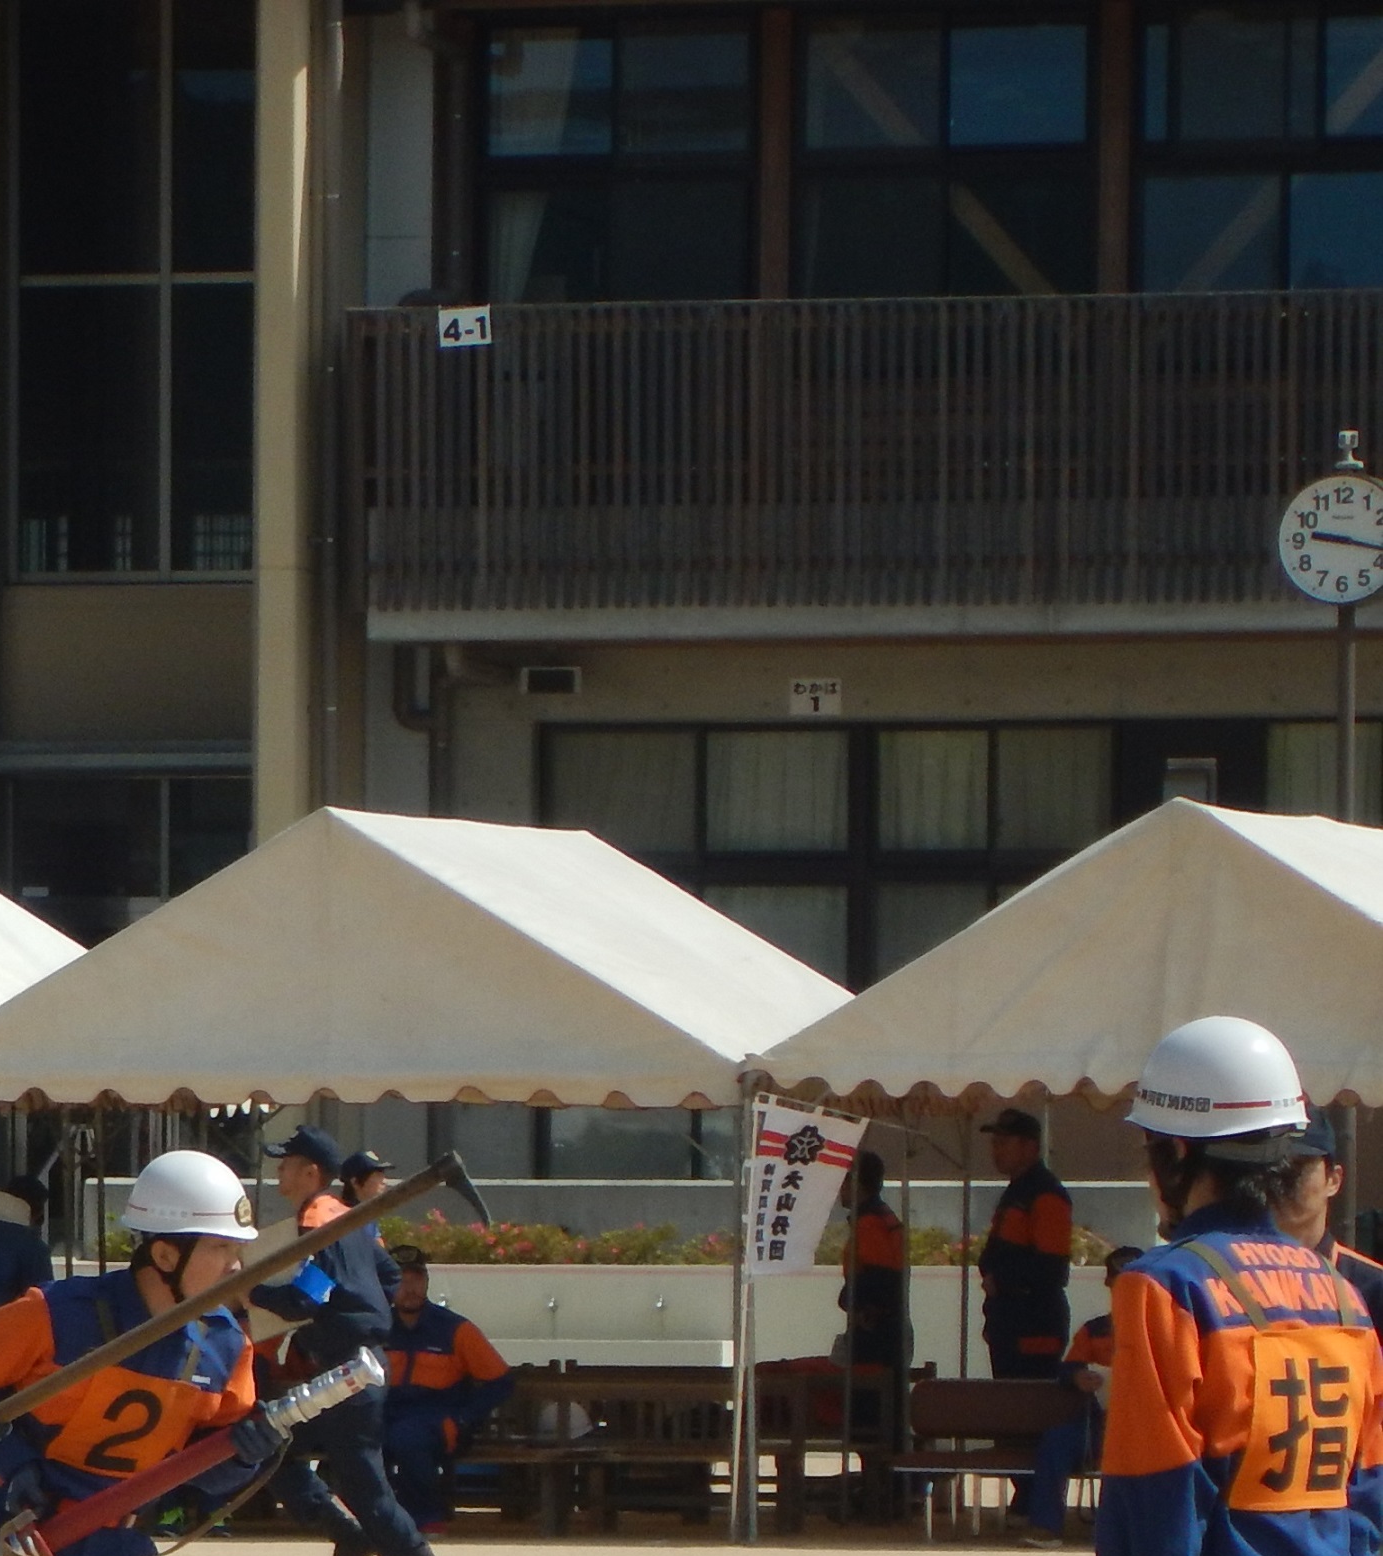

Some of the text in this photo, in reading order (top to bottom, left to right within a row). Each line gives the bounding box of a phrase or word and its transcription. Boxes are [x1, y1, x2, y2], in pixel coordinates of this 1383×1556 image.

[443, 315, 487, 342] 4-1
[1313, 494, 1330, 511] 11
[1334, 487, 1354, 504] 12
[1363, 494, 1371, 511] 1
[1297, 511, 1318, 529] 10
[1292, 532, 1305, 550] 9
[1299, 554, 1312, 572] 8
[1316, 570, 1329, 587] 7
[1336, 576, 1348, 593] 6
[1358, 569, 1370, 586] 5
[810, 696, 820, 712] 1
[1230, 1242, 1321, 1269] HYOGO
[84, 1389, 163, 1473] 2
[1260, 1357, 1351, 1493] 指
